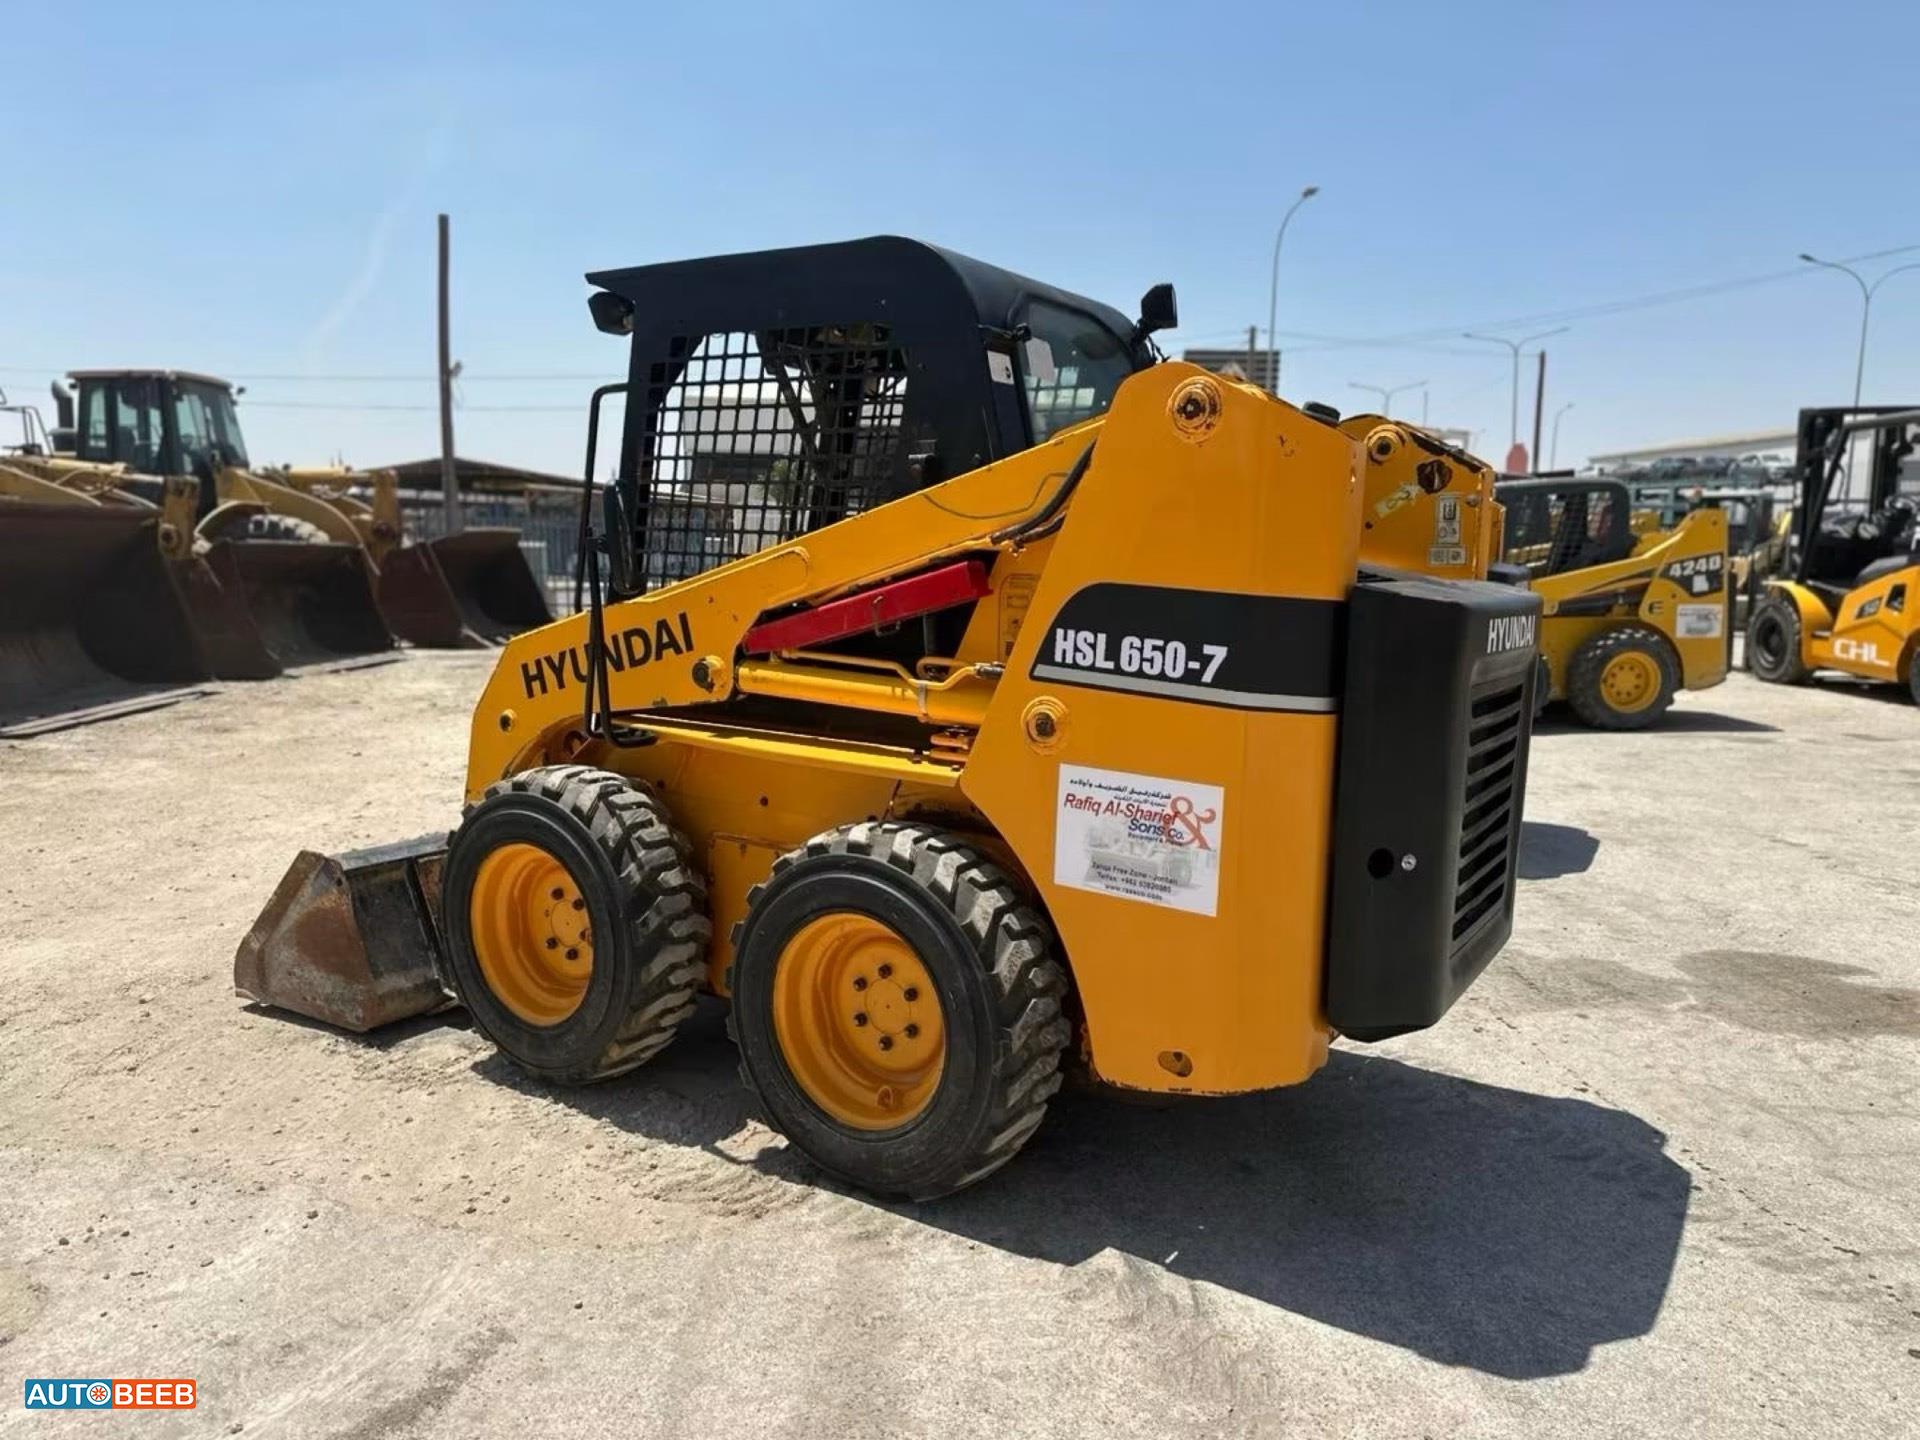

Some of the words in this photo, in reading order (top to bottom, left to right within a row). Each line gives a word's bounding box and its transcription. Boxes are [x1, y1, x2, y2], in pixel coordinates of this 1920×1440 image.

[1487, 615, 1536, 654] HYUNDAI
[521, 612, 694, 699] HYUNDAI
[1054, 628, 1115, 670] HSL
[1119, 635, 1229, 684] 650-7
[1064, 793, 1101, 816] Rafiq
[1103, 800, 1179, 826] Al-Sharief
[1128, 817, 1166, 836] Sons
